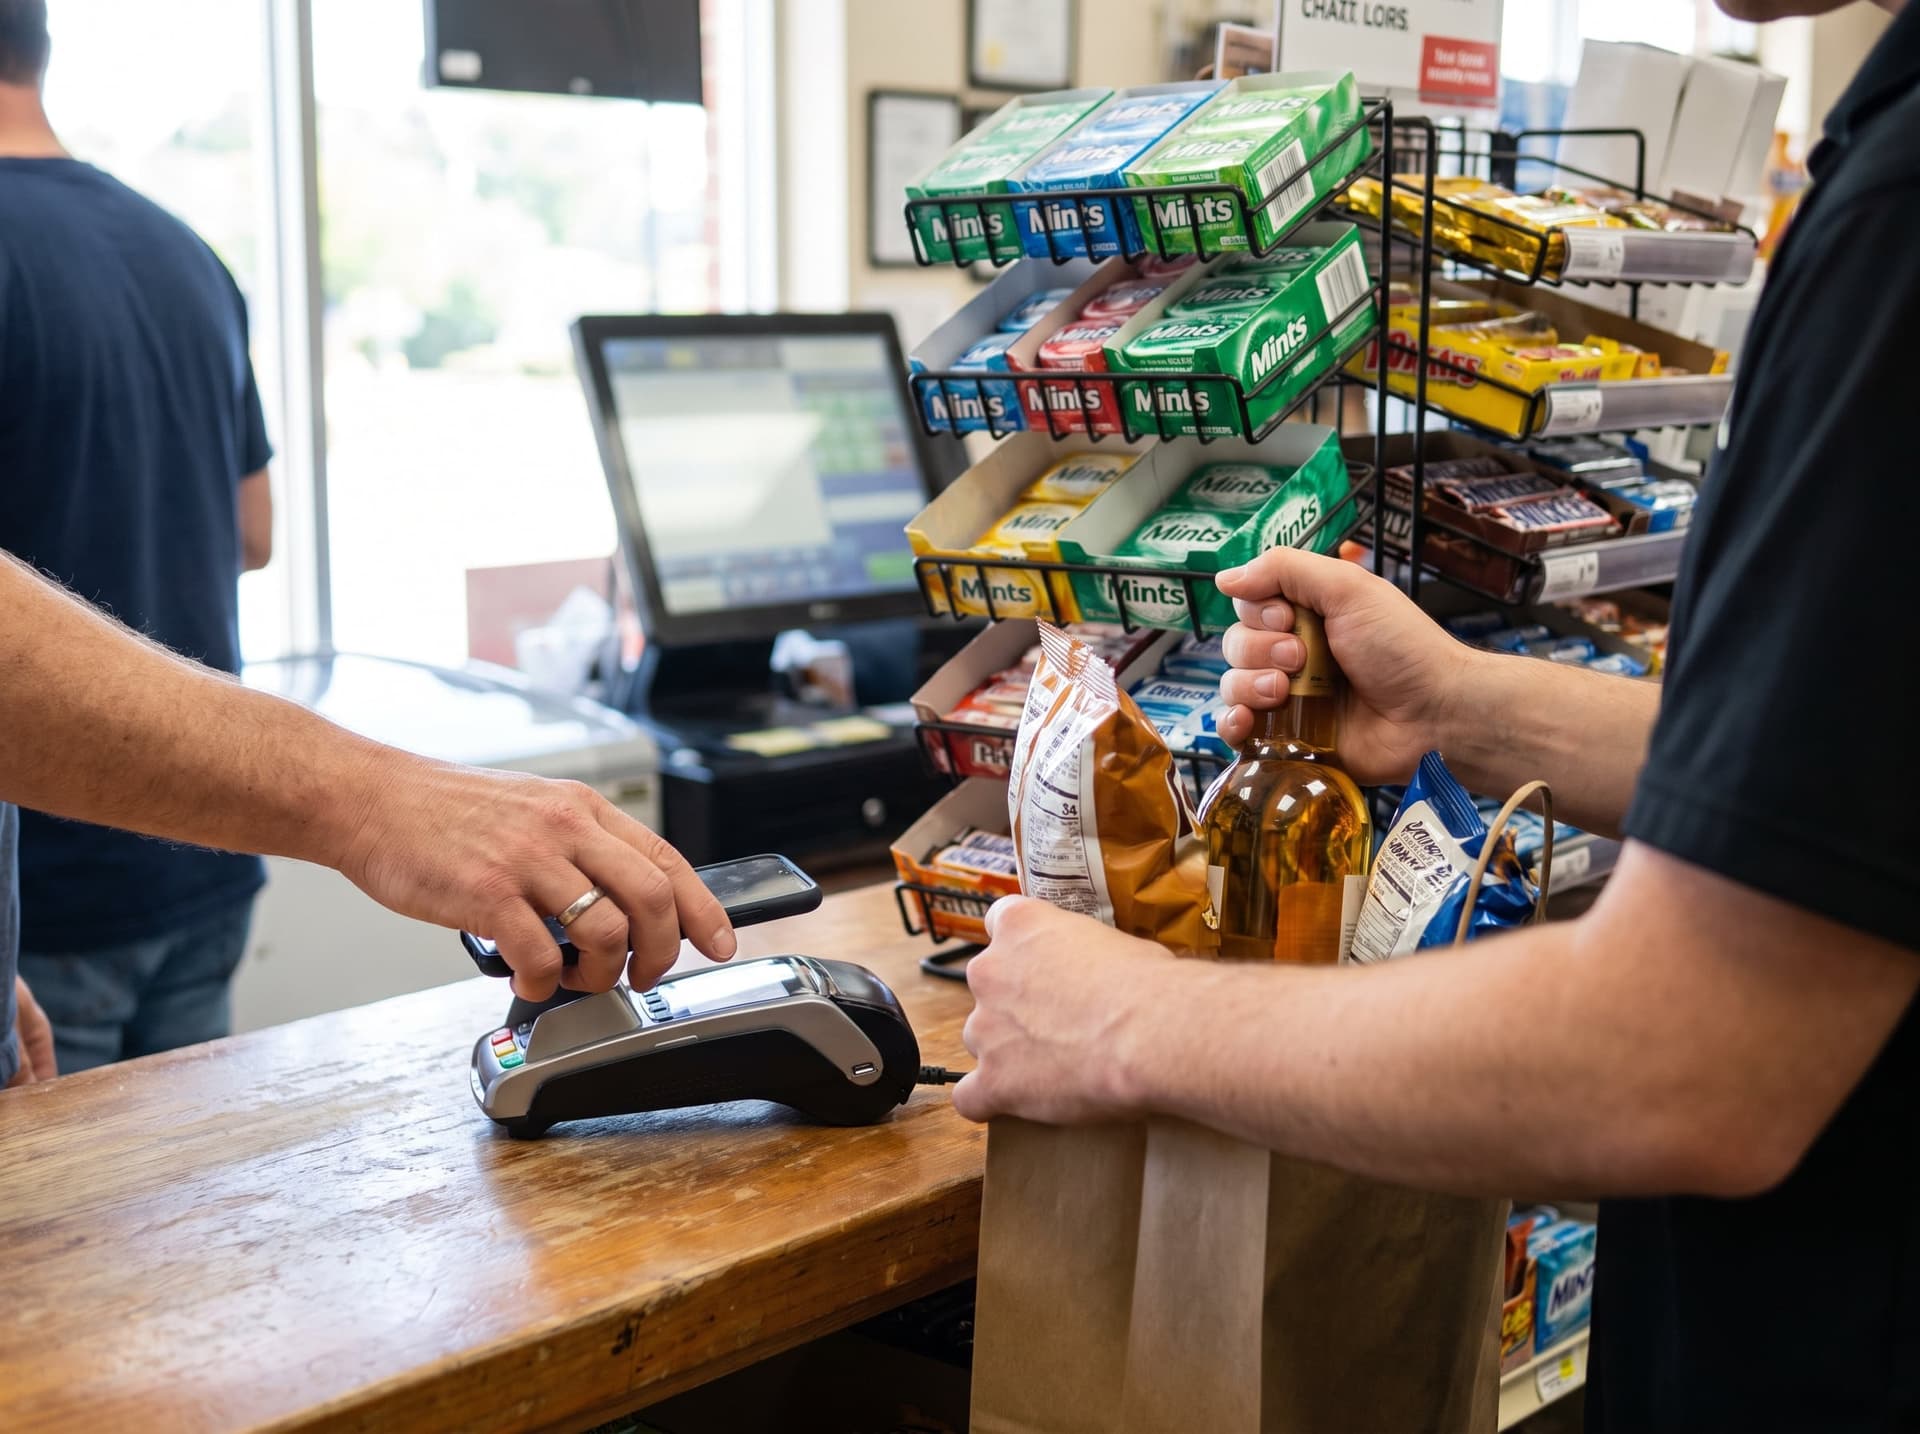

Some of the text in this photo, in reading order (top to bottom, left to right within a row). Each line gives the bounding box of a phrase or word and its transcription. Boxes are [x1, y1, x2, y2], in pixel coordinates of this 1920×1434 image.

[1153, 197, 1233, 228] Mints
[1141, 324, 1226, 341] Mints
[1251, 315, 1308, 383] Mints
[1195, 475, 1280, 495] Mints
[1143, 523, 1235, 543] Mints
[961, 578, 1031, 602] Mnts
[1107, 579, 1185, 606] Mints
